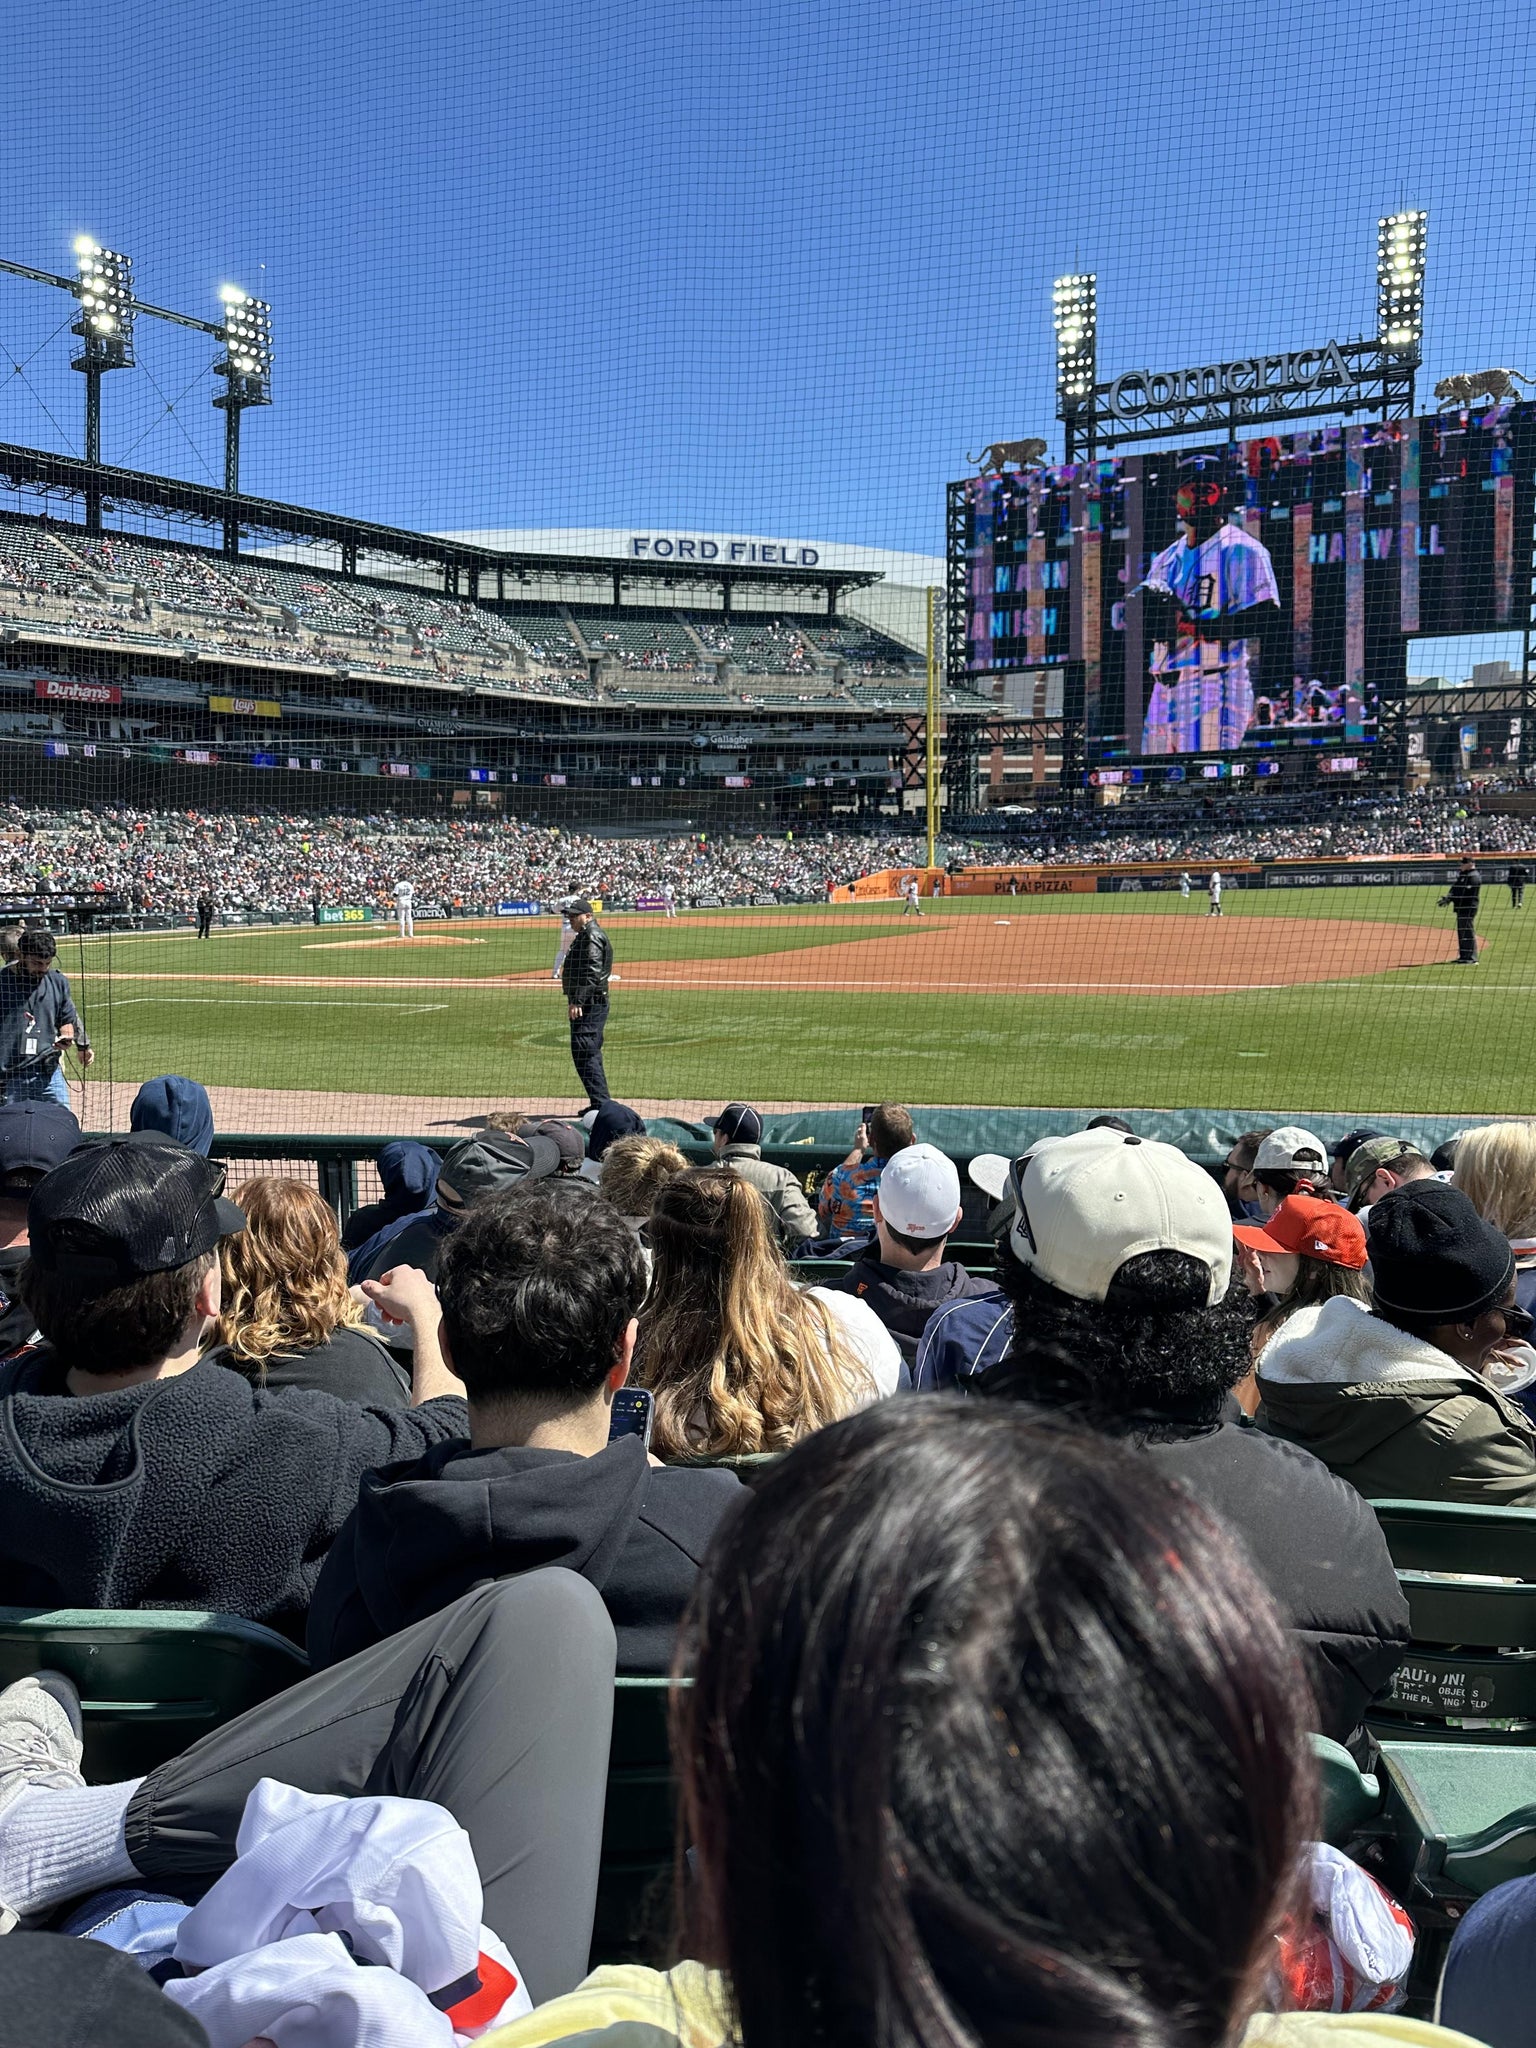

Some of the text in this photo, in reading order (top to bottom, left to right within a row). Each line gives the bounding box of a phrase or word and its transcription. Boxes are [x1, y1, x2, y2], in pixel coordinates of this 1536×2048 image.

[1173, 391, 1288, 425] PARK
[633, 538, 820, 566] FORD FIELD
[47, 681, 112, 700] Dunham's
[710, 734, 754, 745] Gallagher
[1034, 880, 1073, 892] PIZZA!
[323, 909, 365, 923] bet365
[1401, 1692, 1419, 1702] THE
[1420, 1695, 1460, 1707] PLING
